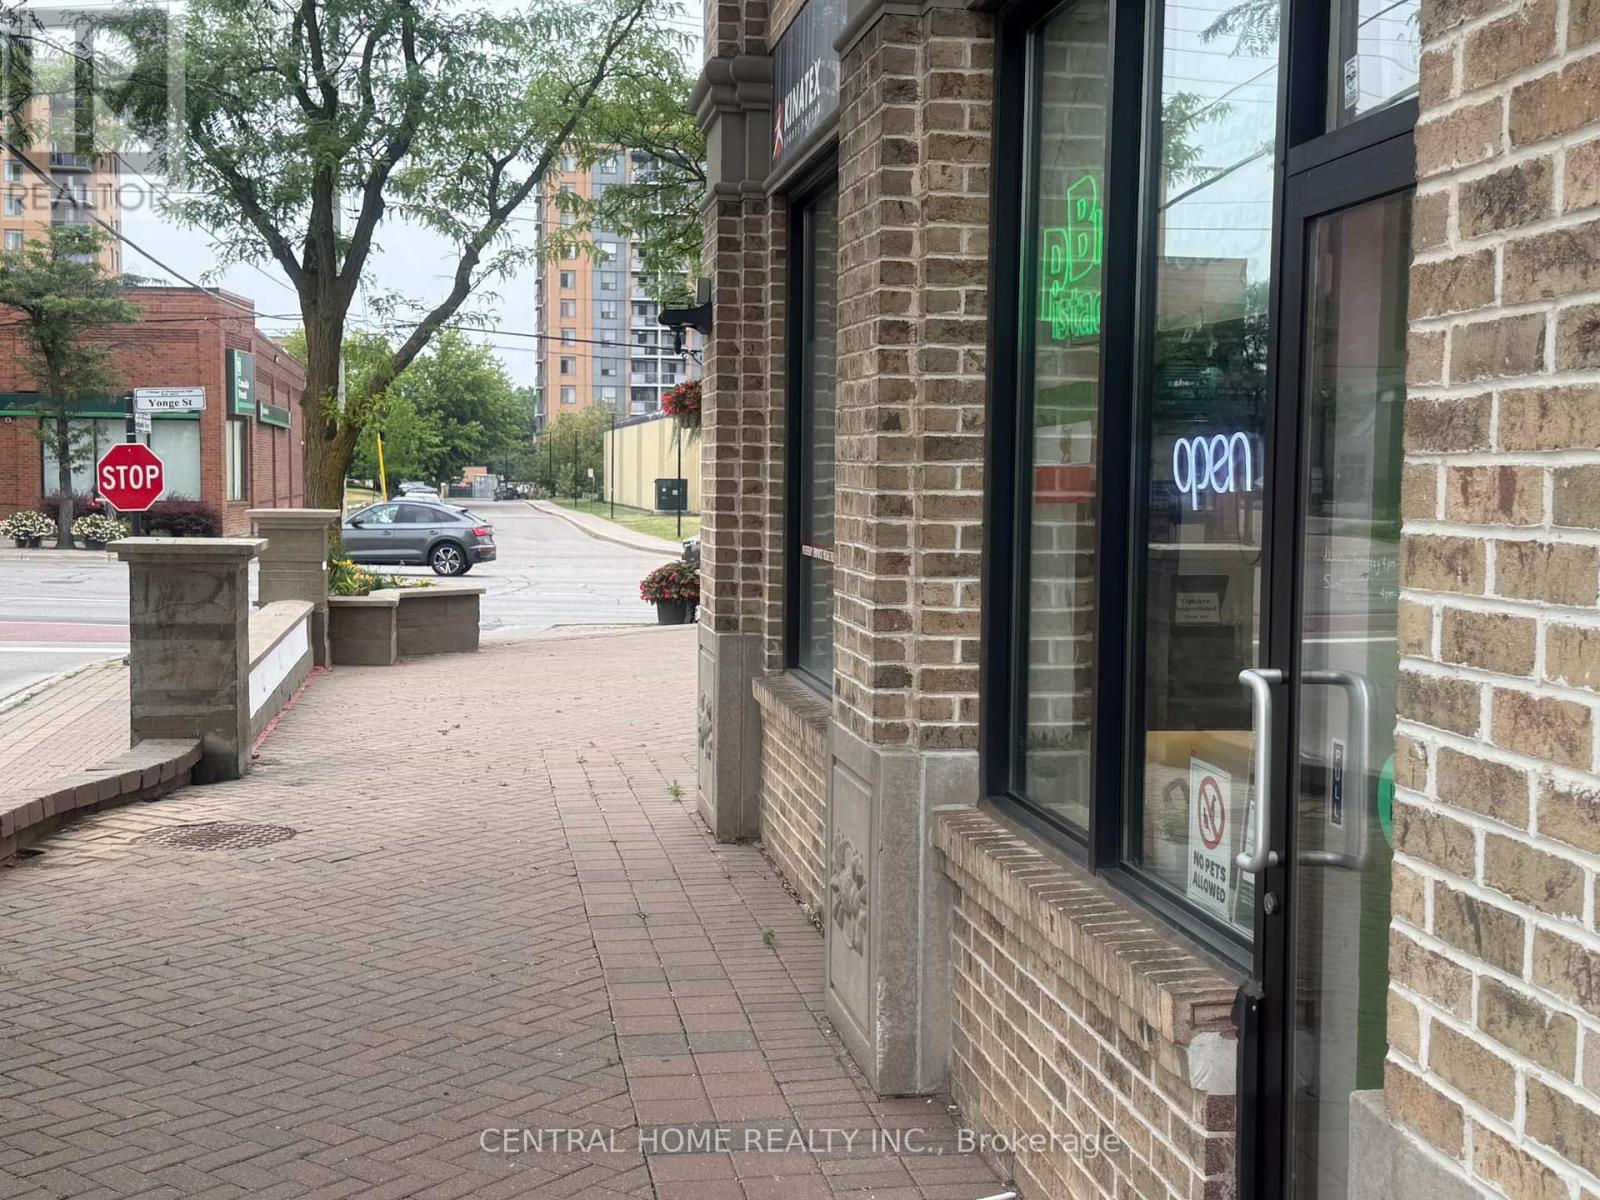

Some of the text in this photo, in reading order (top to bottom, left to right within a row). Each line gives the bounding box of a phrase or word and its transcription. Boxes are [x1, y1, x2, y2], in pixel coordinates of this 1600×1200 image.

[784, 57, 821, 132] KINATEX
[149, 398, 193, 410] Yonge St
[102, 464, 160, 490] STOP
[1173, 431, 1252, 511] open
[1193, 850, 1227, 882] NO PETS
[1192, 870, 1226, 904] ALLOWED
